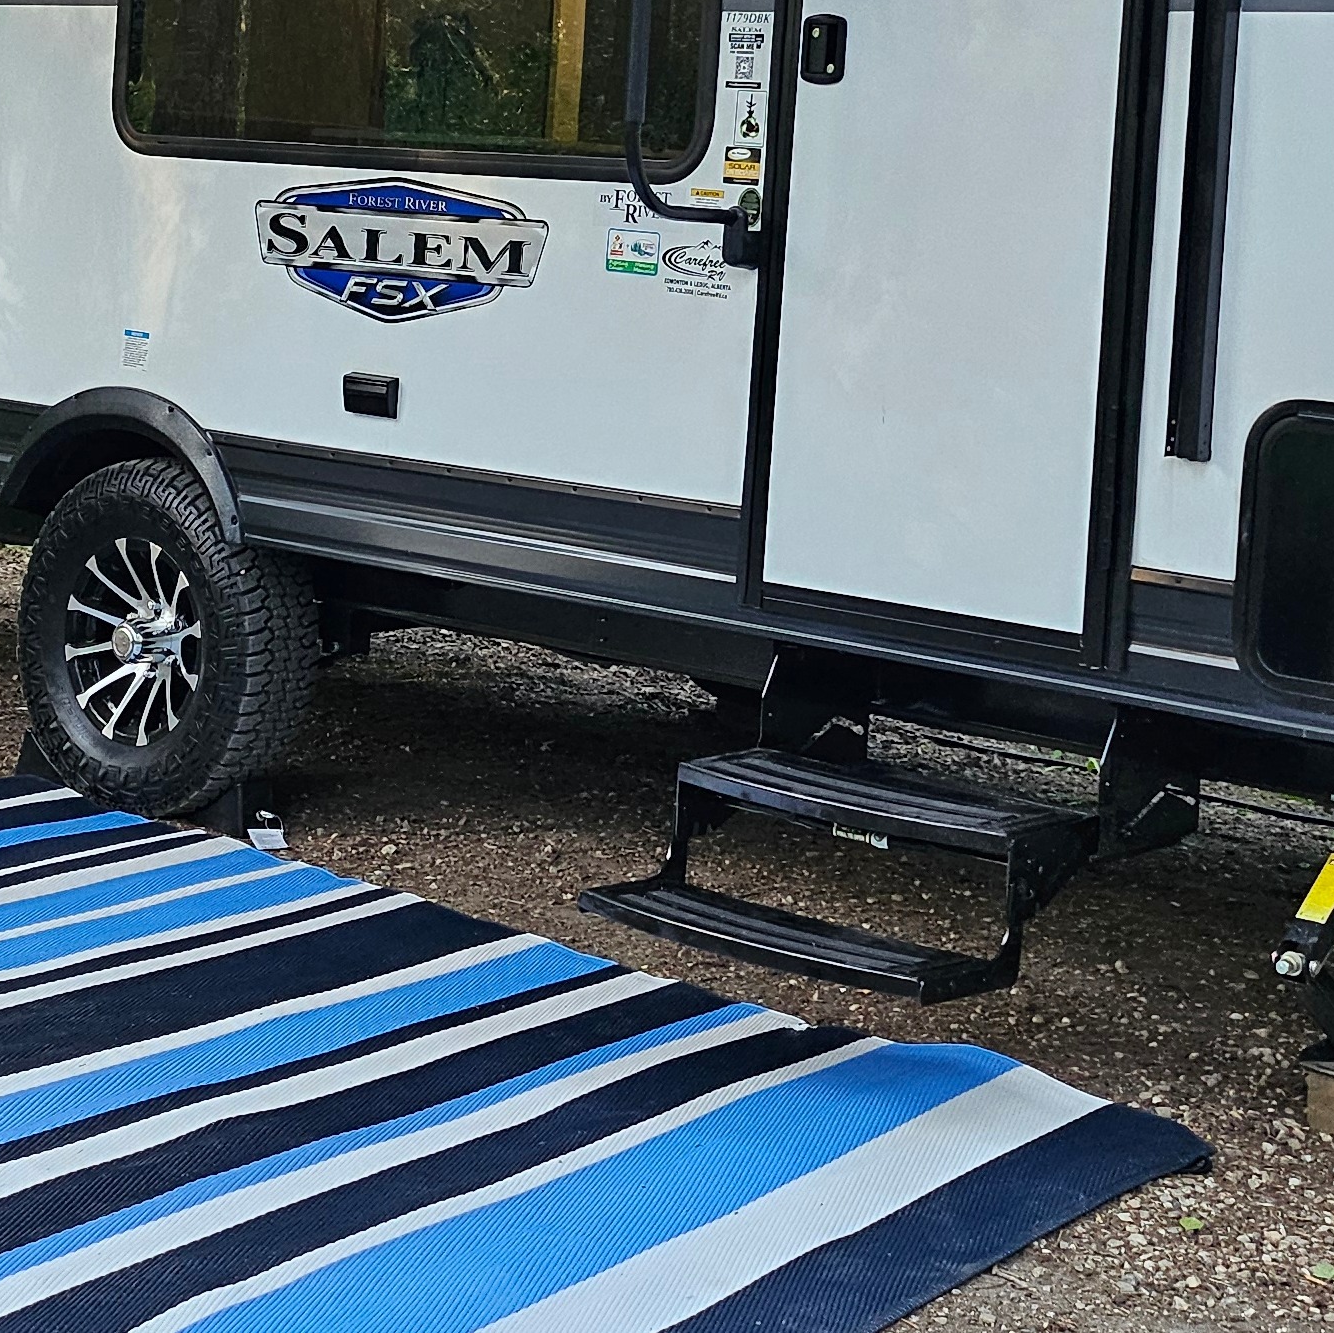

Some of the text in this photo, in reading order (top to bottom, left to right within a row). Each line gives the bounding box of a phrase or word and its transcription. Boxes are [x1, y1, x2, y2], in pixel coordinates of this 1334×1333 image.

[348, 192, 448, 213] FOREST RIVER
[599, 194, 613, 204] BY
[266, 213, 533, 278] SALEM
[674, 250, 727, 271] Carefree
[707, 270, 727, 281] RV
[339, 276, 450, 312] FSX
